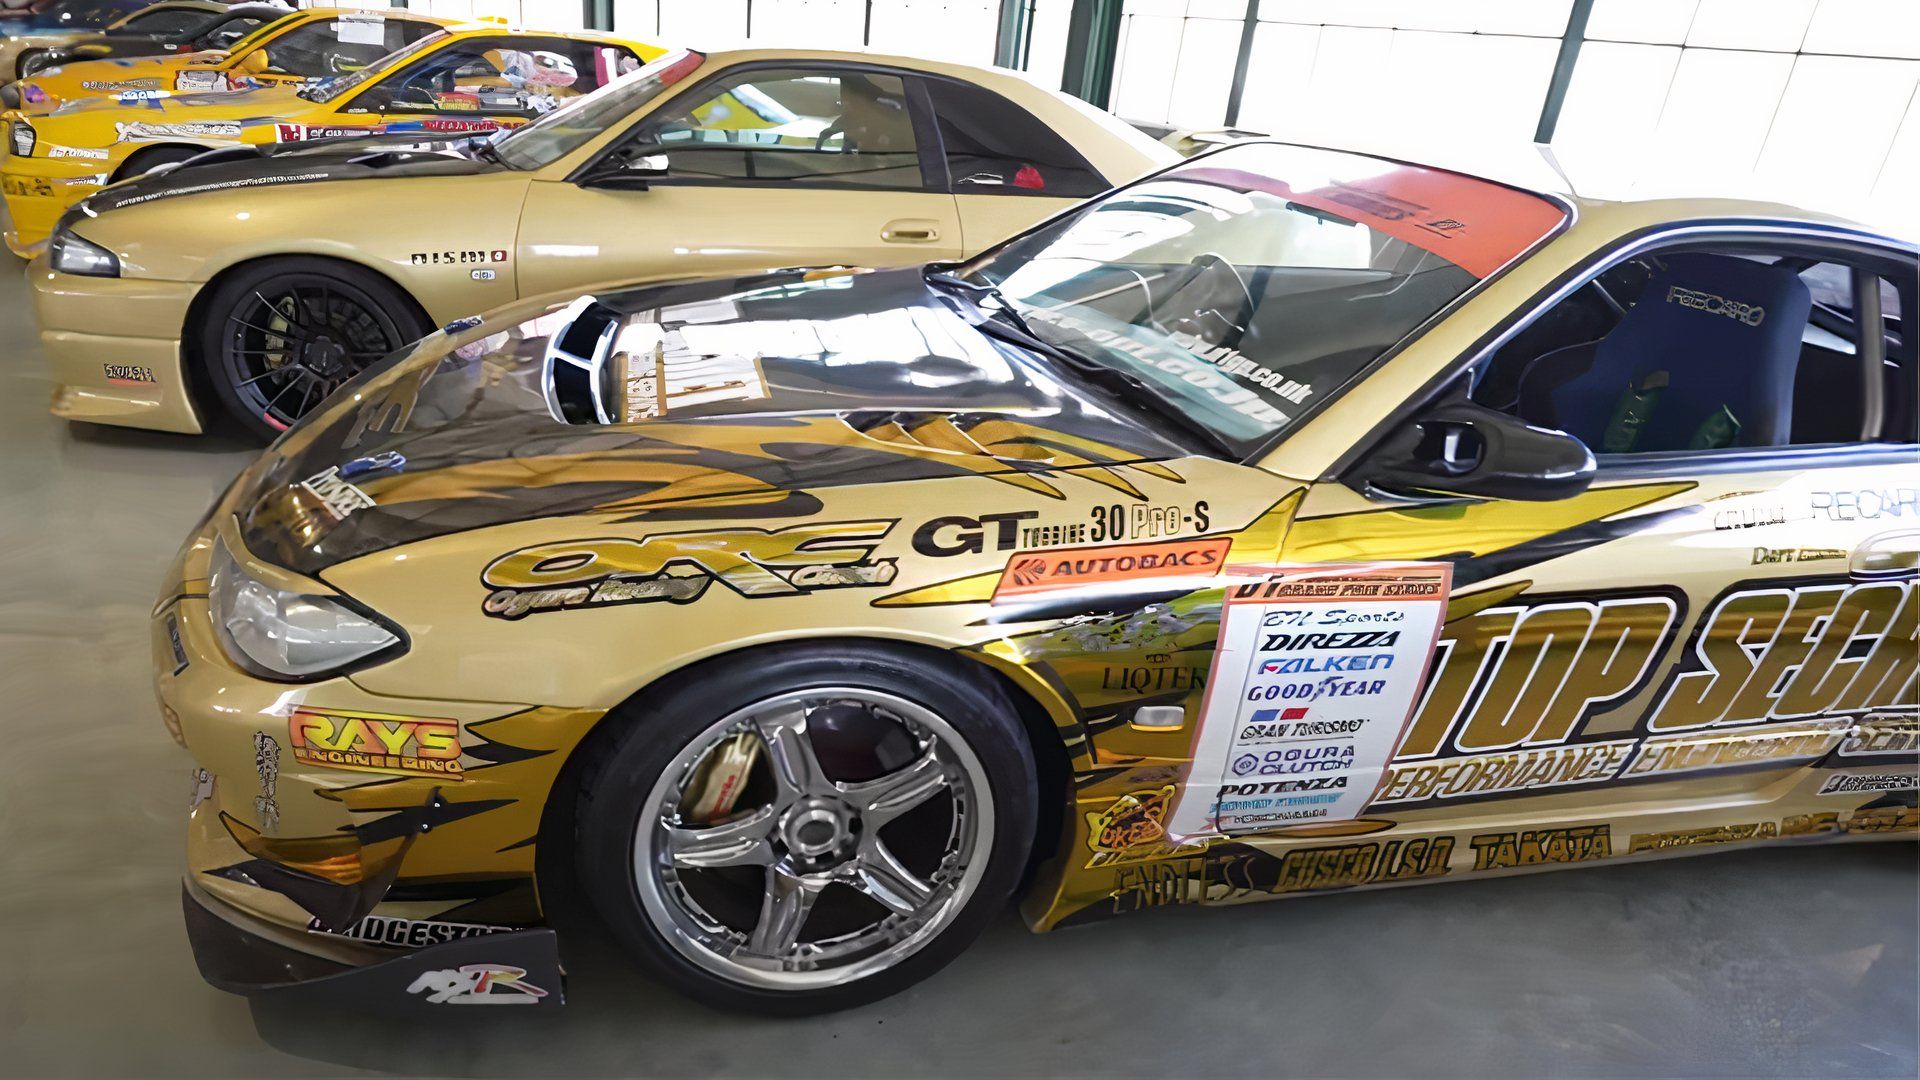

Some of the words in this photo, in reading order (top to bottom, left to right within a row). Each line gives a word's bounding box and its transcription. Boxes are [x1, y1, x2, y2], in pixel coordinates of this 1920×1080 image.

[911, 511, 1039, 557] GT
[1091, 504, 1126, 542] 30
[1051, 550, 1217, 576] AUTOBACS
[1257, 654, 1395, 675] FALKEN
[1260, 630, 1401, 652] DIREZZA
[1248, 676, 1386, 702] GOODYEAR
[1395, 595, 1680, 760] TOP
[1645, 581, 1920, 732] SECR
[288, 711, 462, 760] RAYS
[1377, 742, 1634, 801] PERFORMANCE
[1470, 824, 1612, 871] TAKATA
